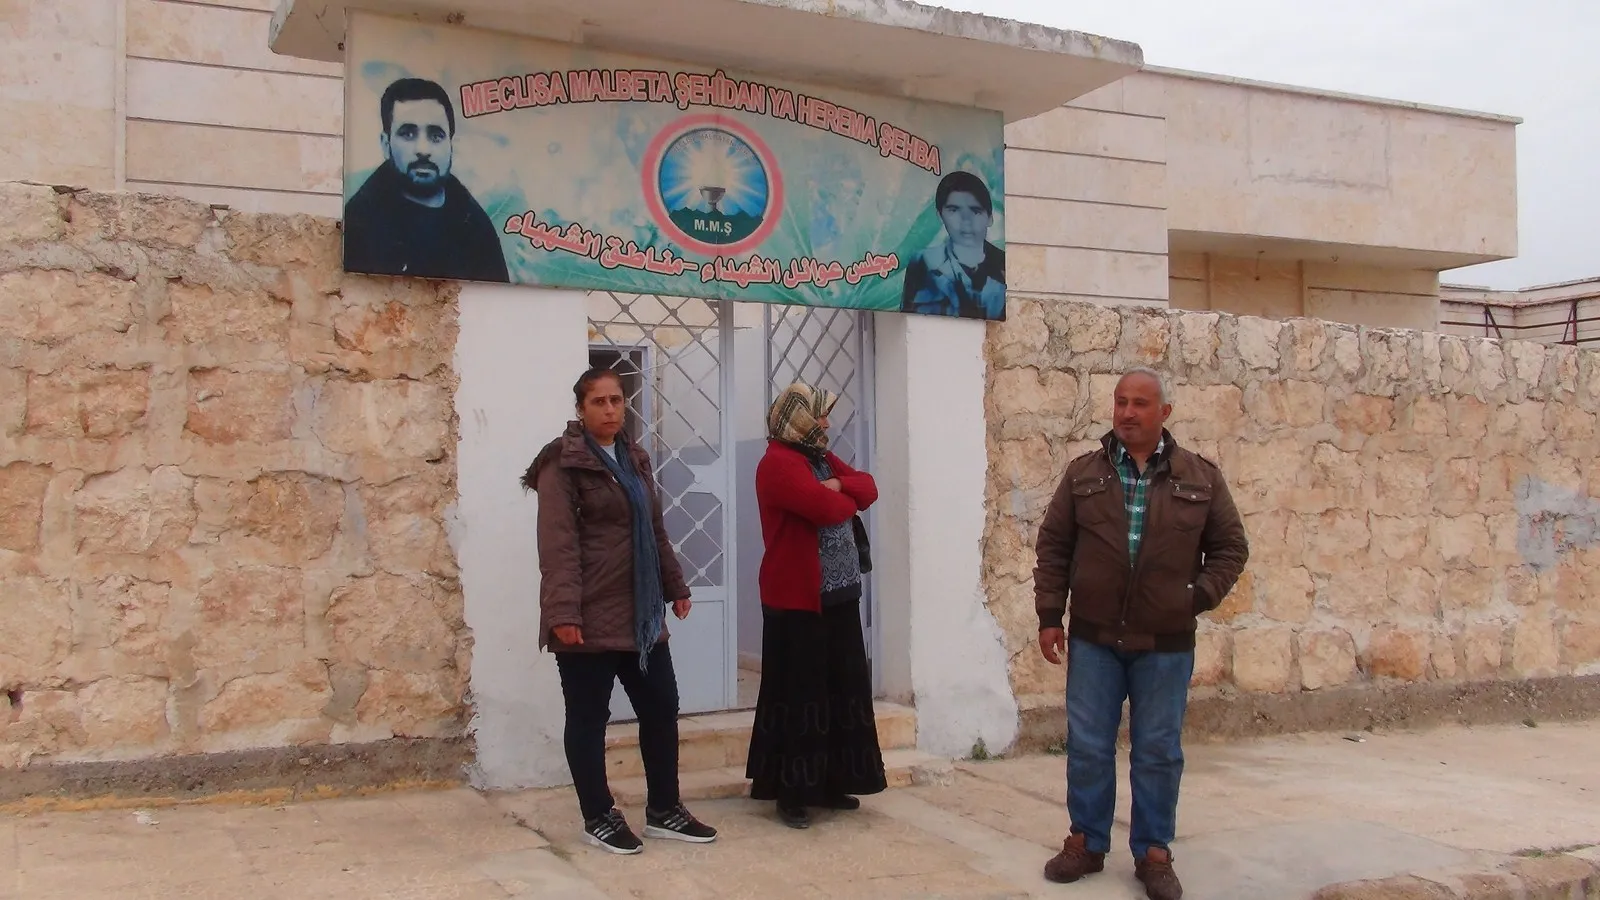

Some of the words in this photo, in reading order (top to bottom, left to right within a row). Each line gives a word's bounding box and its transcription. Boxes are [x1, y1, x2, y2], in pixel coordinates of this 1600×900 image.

[460, 71, 568, 118] MECLISA
[567, 69, 672, 103] MALBETA
[674, 68, 767, 115] ŞEHÎDAN
[768, 87, 797, 122] YA
[797, 94, 878, 147] HEREMA
[879, 122, 941, 176] ŞEHBA
[504, 210, 602, 259] الشهباء
[694, 219, 732, 236] M.M.Ş
[782, 257, 845, 288] عوائل
[845, 251, 900, 285] مجلس
